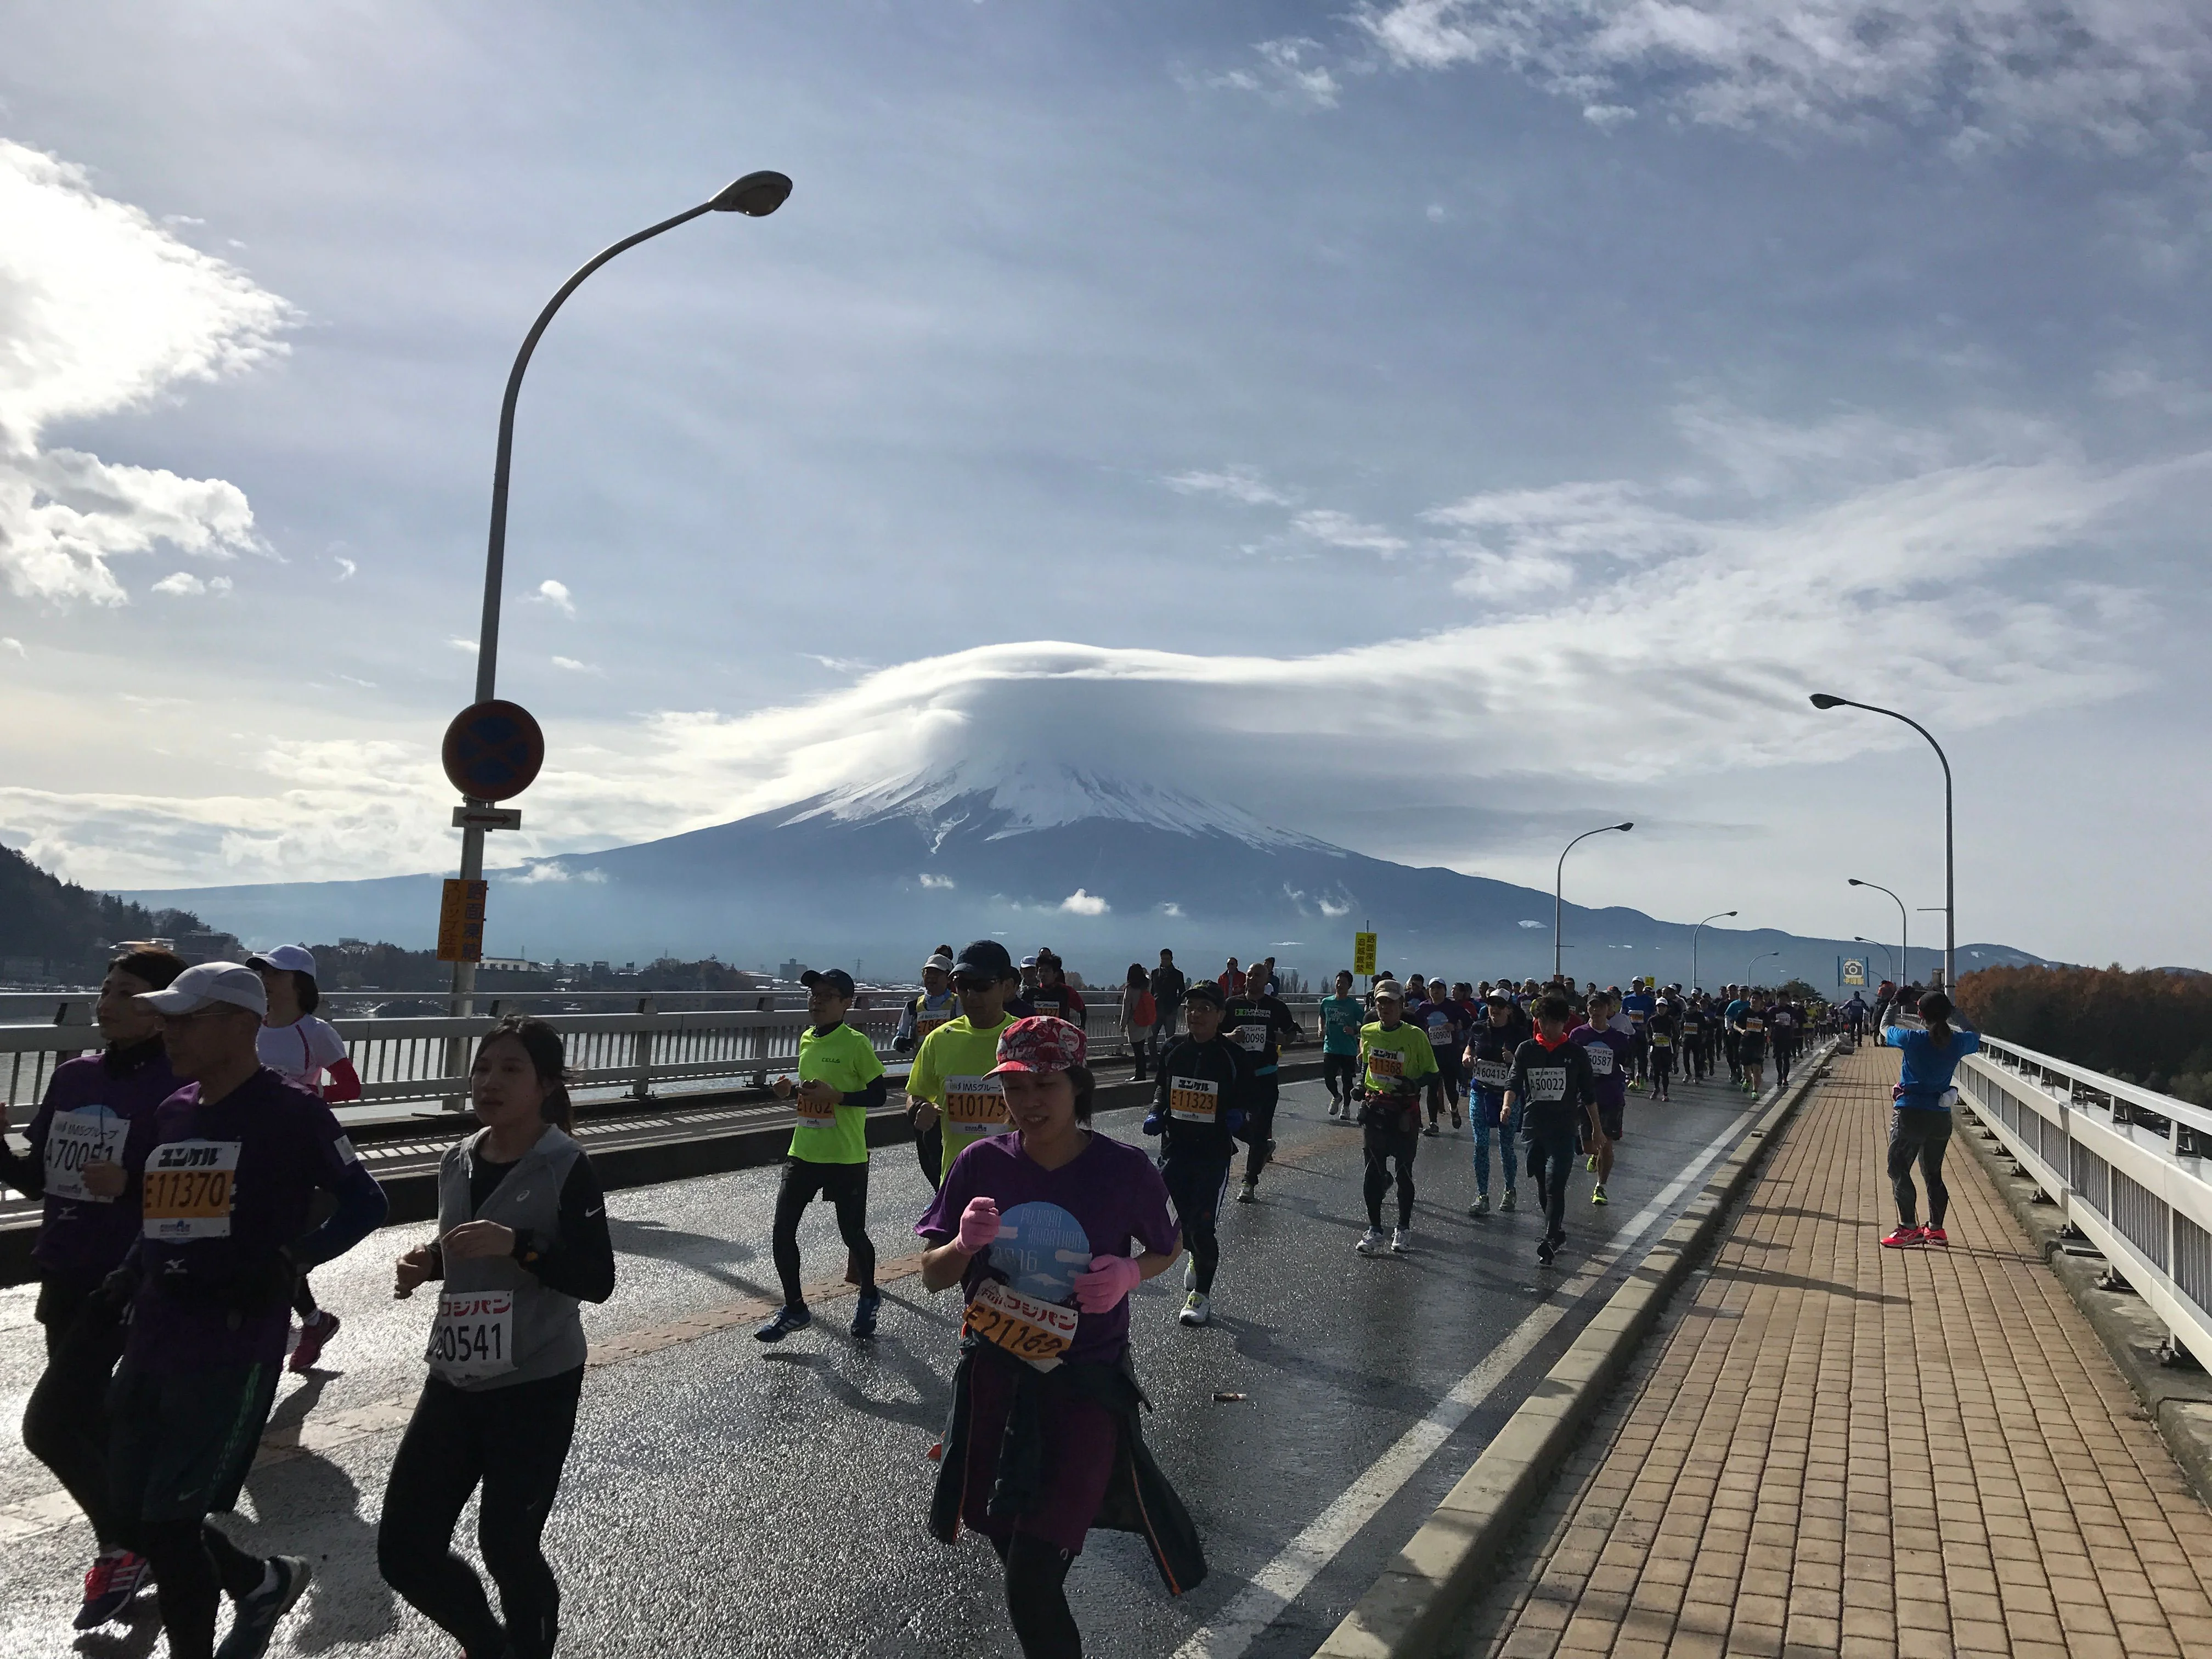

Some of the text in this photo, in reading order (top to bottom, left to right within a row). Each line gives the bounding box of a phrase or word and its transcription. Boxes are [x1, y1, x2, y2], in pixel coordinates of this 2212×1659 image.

[1243, 1033, 1265, 1043] 0098
[1530, 1077, 1564, 1091] A50022
[947, 1094, 1006, 1118] E10175
[1171, 1090, 1214, 1110] E11323
[144, 1172, 226, 1209] E11370
